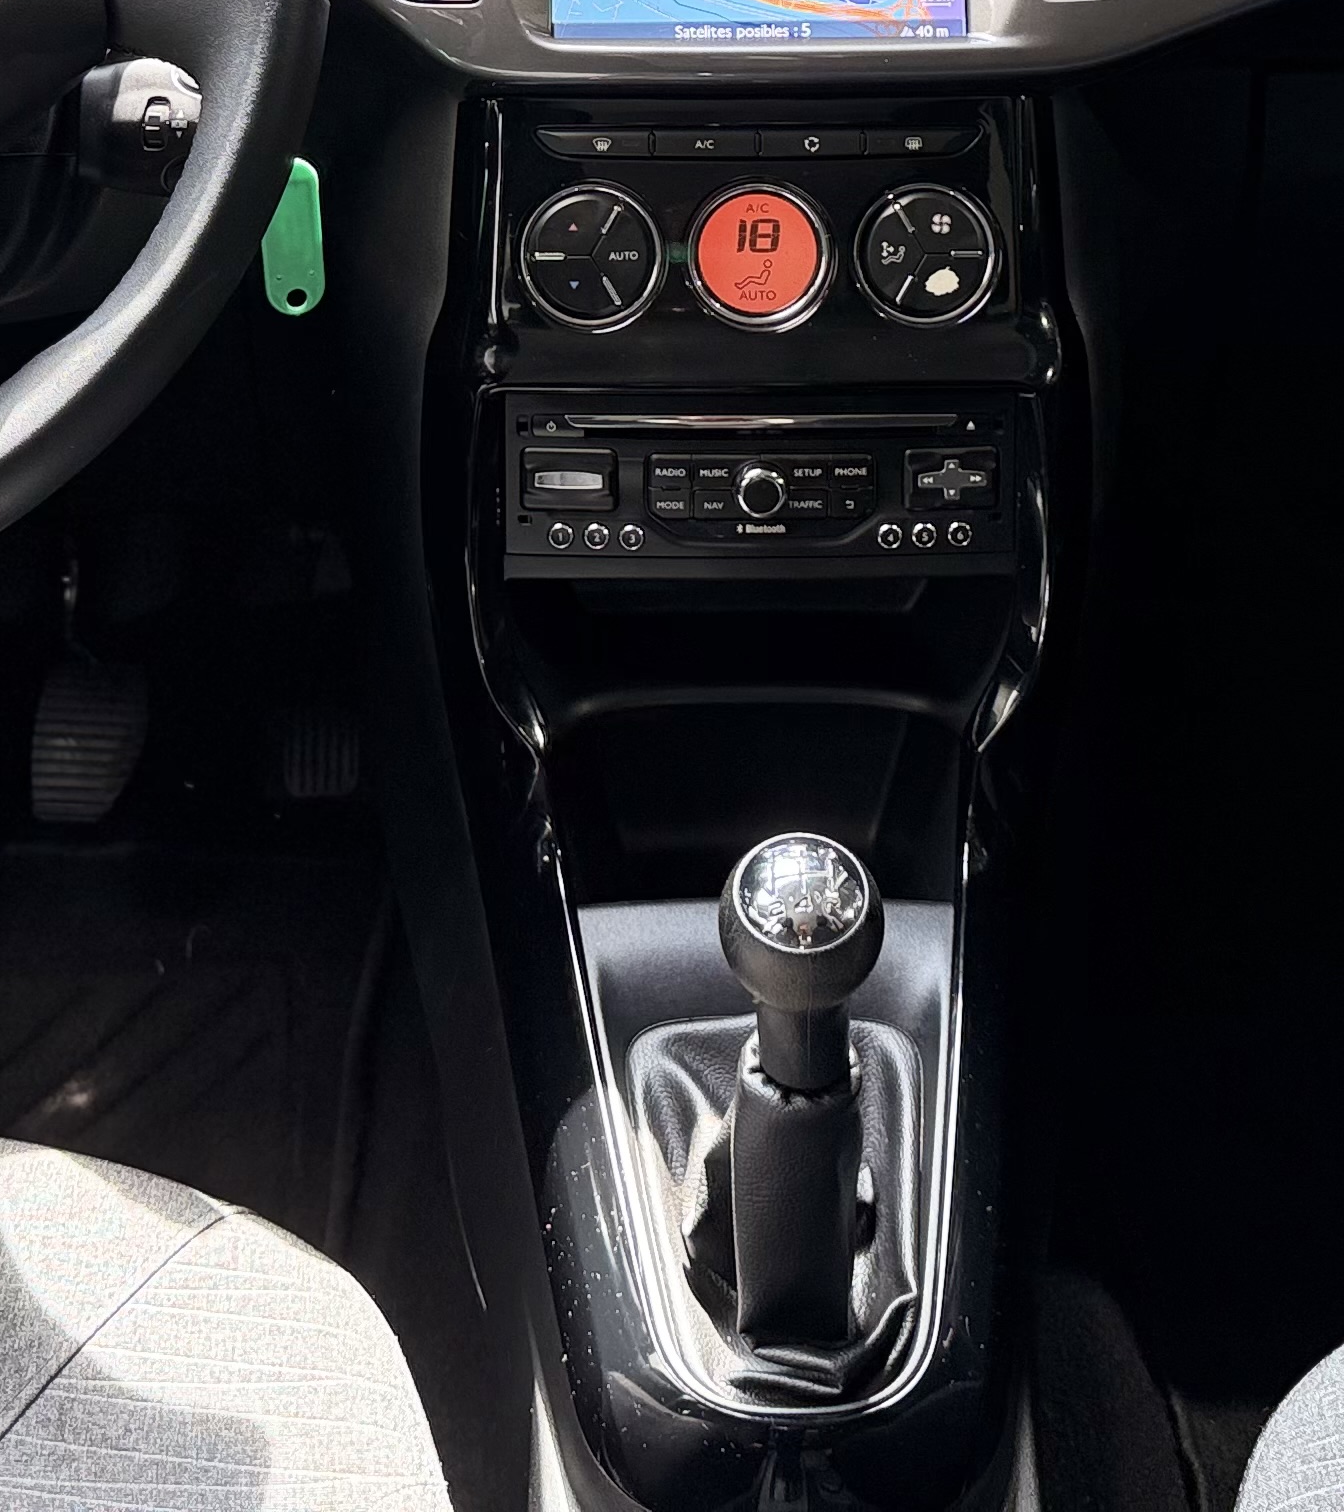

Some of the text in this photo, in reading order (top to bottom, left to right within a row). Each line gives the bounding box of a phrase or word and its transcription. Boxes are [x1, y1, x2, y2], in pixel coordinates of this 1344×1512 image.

[736, 24, 790, 40] posibles
[694, 139, 715, 150] A/C
[745, 202, 770, 214] A/C
[736, 218, 781, 254] 18
[608, 250, 640, 262] AUTO
[738, 289, 777, 302] AUTO
[655, 467, 687, 478] RADIO
[699, 468, 729, 478] MUSIC
[793, 468, 823, 478] SETUP
[834, 467, 868, 477] PHONE
[656, 500, 685, 510] MODE
[703, 501, 725, 511] NAV
[788, 499, 824, 509] TRAFFIC
[745, 524, 787, 534] Bluetooth
[592, 532, 602, 542] 2
[628, 533, 636, 544] 3
[921, 531, 929, 542] 5
[956, 530, 965, 541] 6
